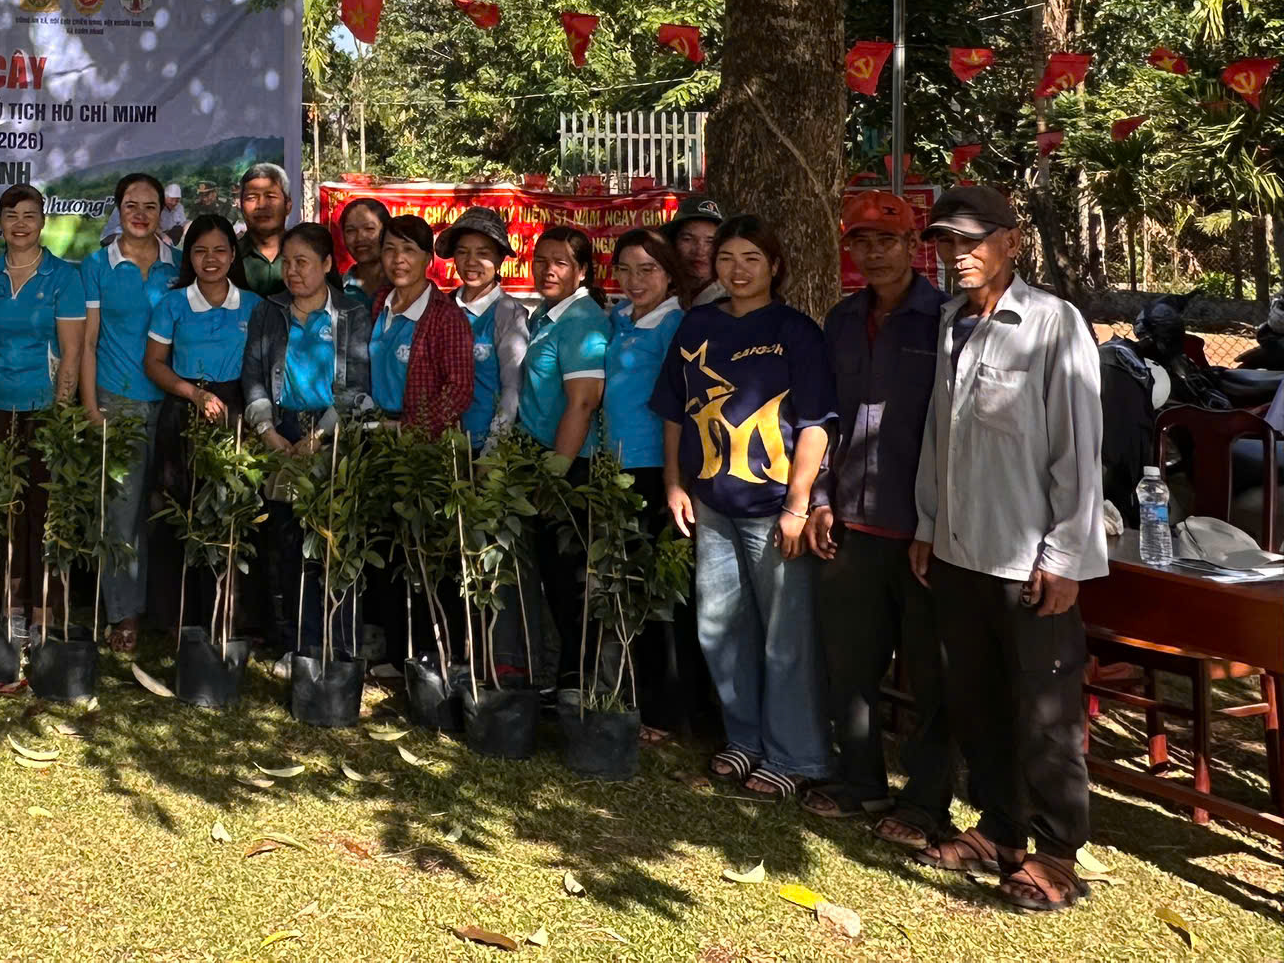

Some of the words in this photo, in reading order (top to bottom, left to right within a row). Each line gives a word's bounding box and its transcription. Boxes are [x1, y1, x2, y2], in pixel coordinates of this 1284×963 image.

[8, 102, 46, 124] TỊCH
[79, 101, 107, 123] CHÍ
[113, 105, 157, 123] MINH
[604, 206, 637, 226] NGÀY
